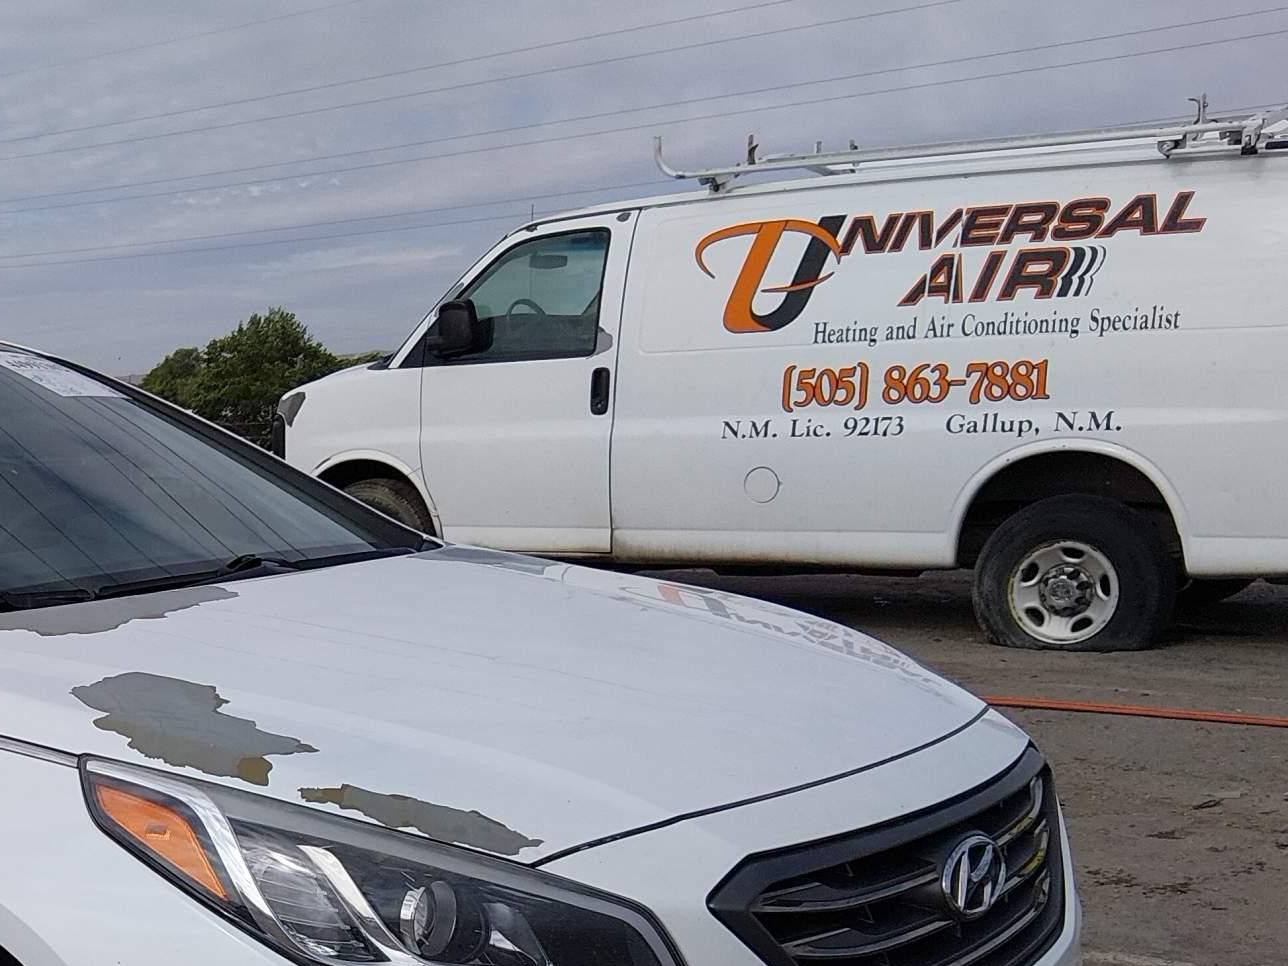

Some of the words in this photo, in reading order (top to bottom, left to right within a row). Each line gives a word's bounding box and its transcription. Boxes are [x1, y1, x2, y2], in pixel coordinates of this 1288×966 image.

[695, 191, 1206, 334] UNIVERSAL
[897, 247, 1070, 306] AIR
[812, 321, 878, 347] Heating
[885, 317, 917, 341] and
[924, 316, 954, 338] Air
[961, 310, 1080, 338] Conditioning
[1089, 305, 1181, 337] Specialist
[782, 362, 870, 412] (505)
[882, 359, 1050, 404] 863-7881
[721, 420, 777, 439] N.M.
[790, 419, 831, 438] Lic.
[843, 415, 904, 437] 92173
[945, 413, 1040, 437] Gallup,
[1053, 410, 1123, 432] N.M.
